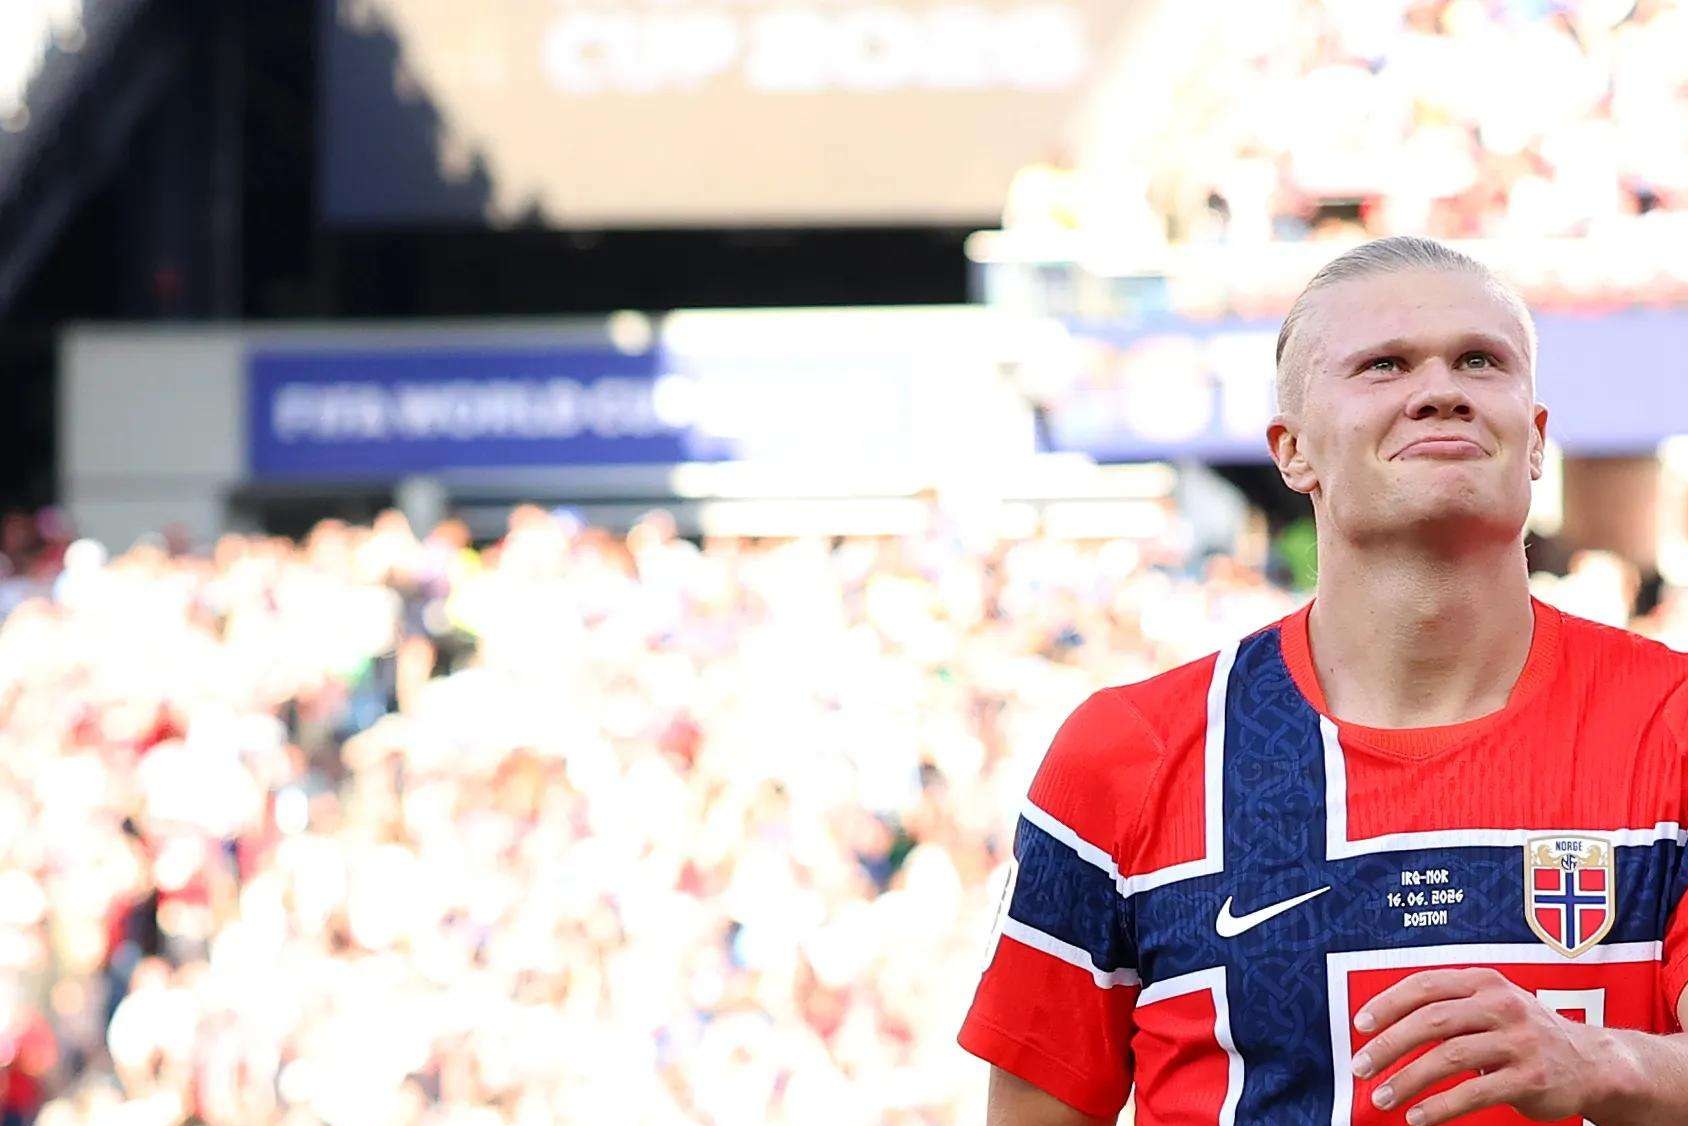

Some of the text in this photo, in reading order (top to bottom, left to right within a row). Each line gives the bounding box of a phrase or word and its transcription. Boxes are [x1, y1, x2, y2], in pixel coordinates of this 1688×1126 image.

[1556, 841, 1582, 852] NORGE
[1401, 869, 1449, 886] IRQ-NOR
[1403, 910, 1448, 927] BOSTON
